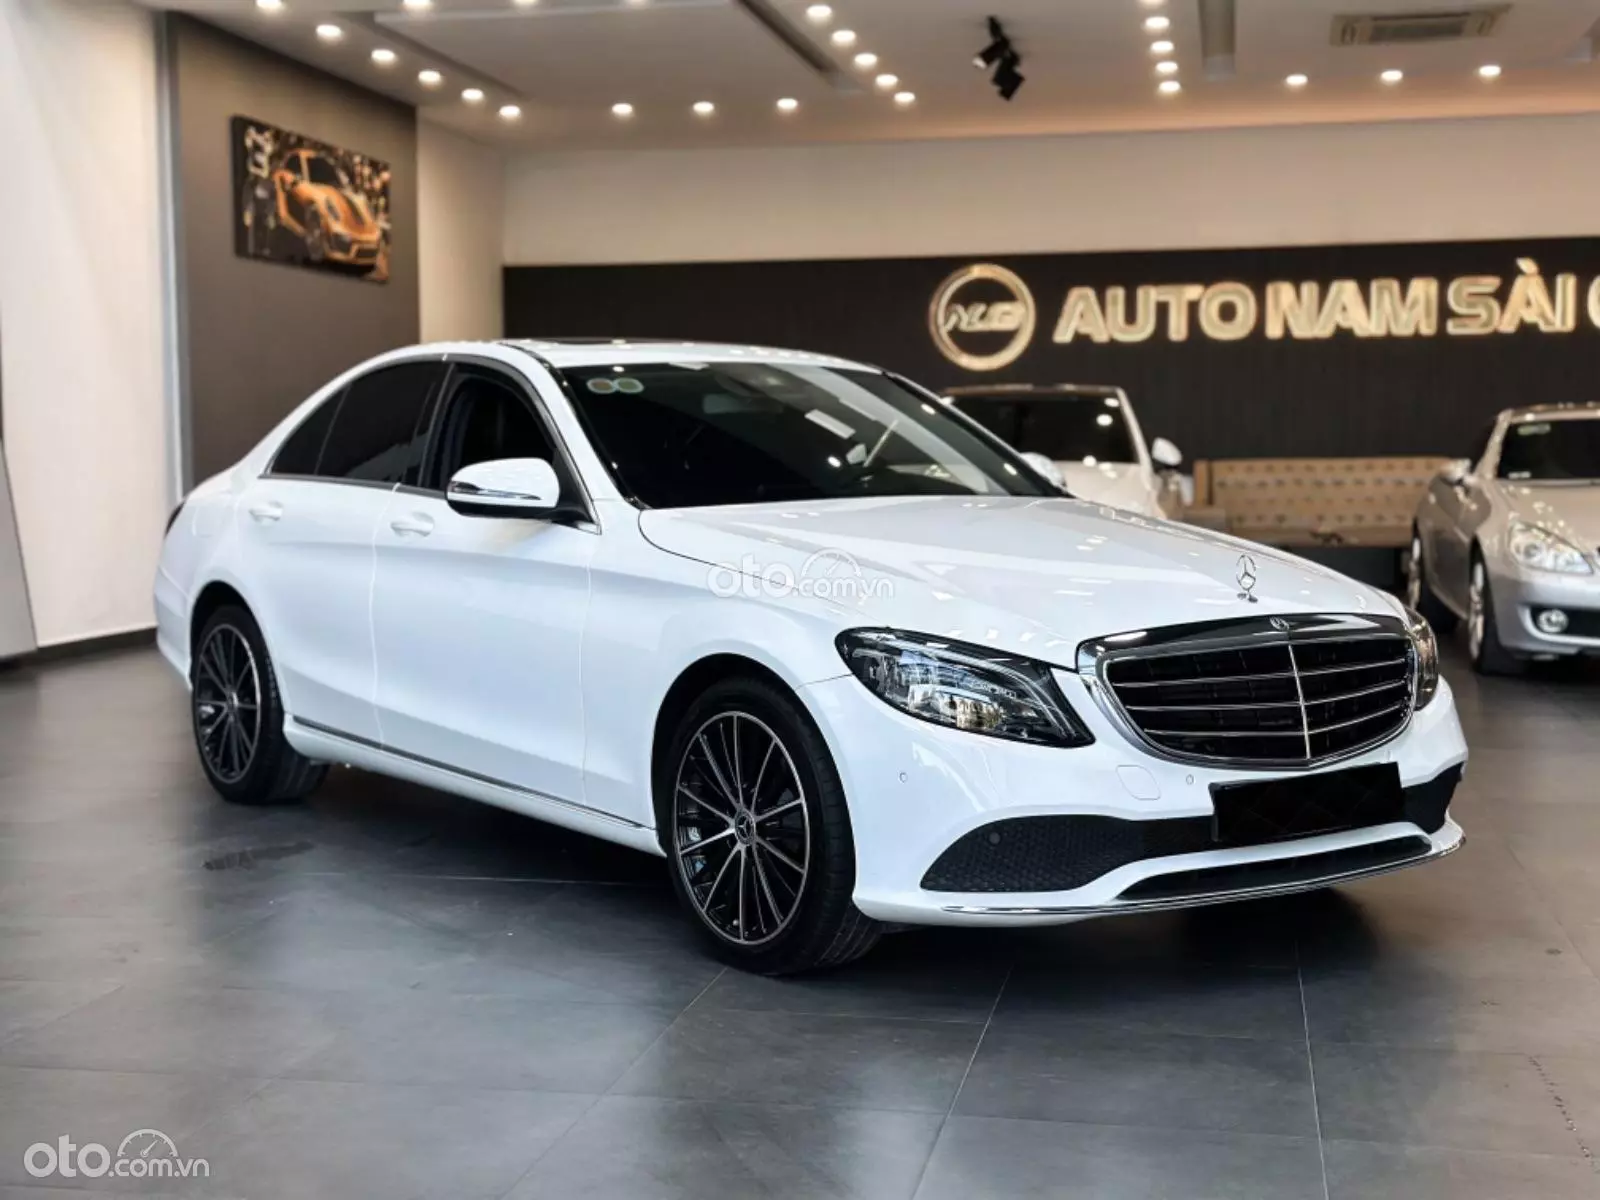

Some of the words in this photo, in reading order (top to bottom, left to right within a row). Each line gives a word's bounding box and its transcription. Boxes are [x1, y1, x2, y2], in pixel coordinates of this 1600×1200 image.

[1052, 282, 1257, 343] AUTO
[1265, 277, 1437, 338] NAM
[1446, 257, 1577, 335] SÀI
